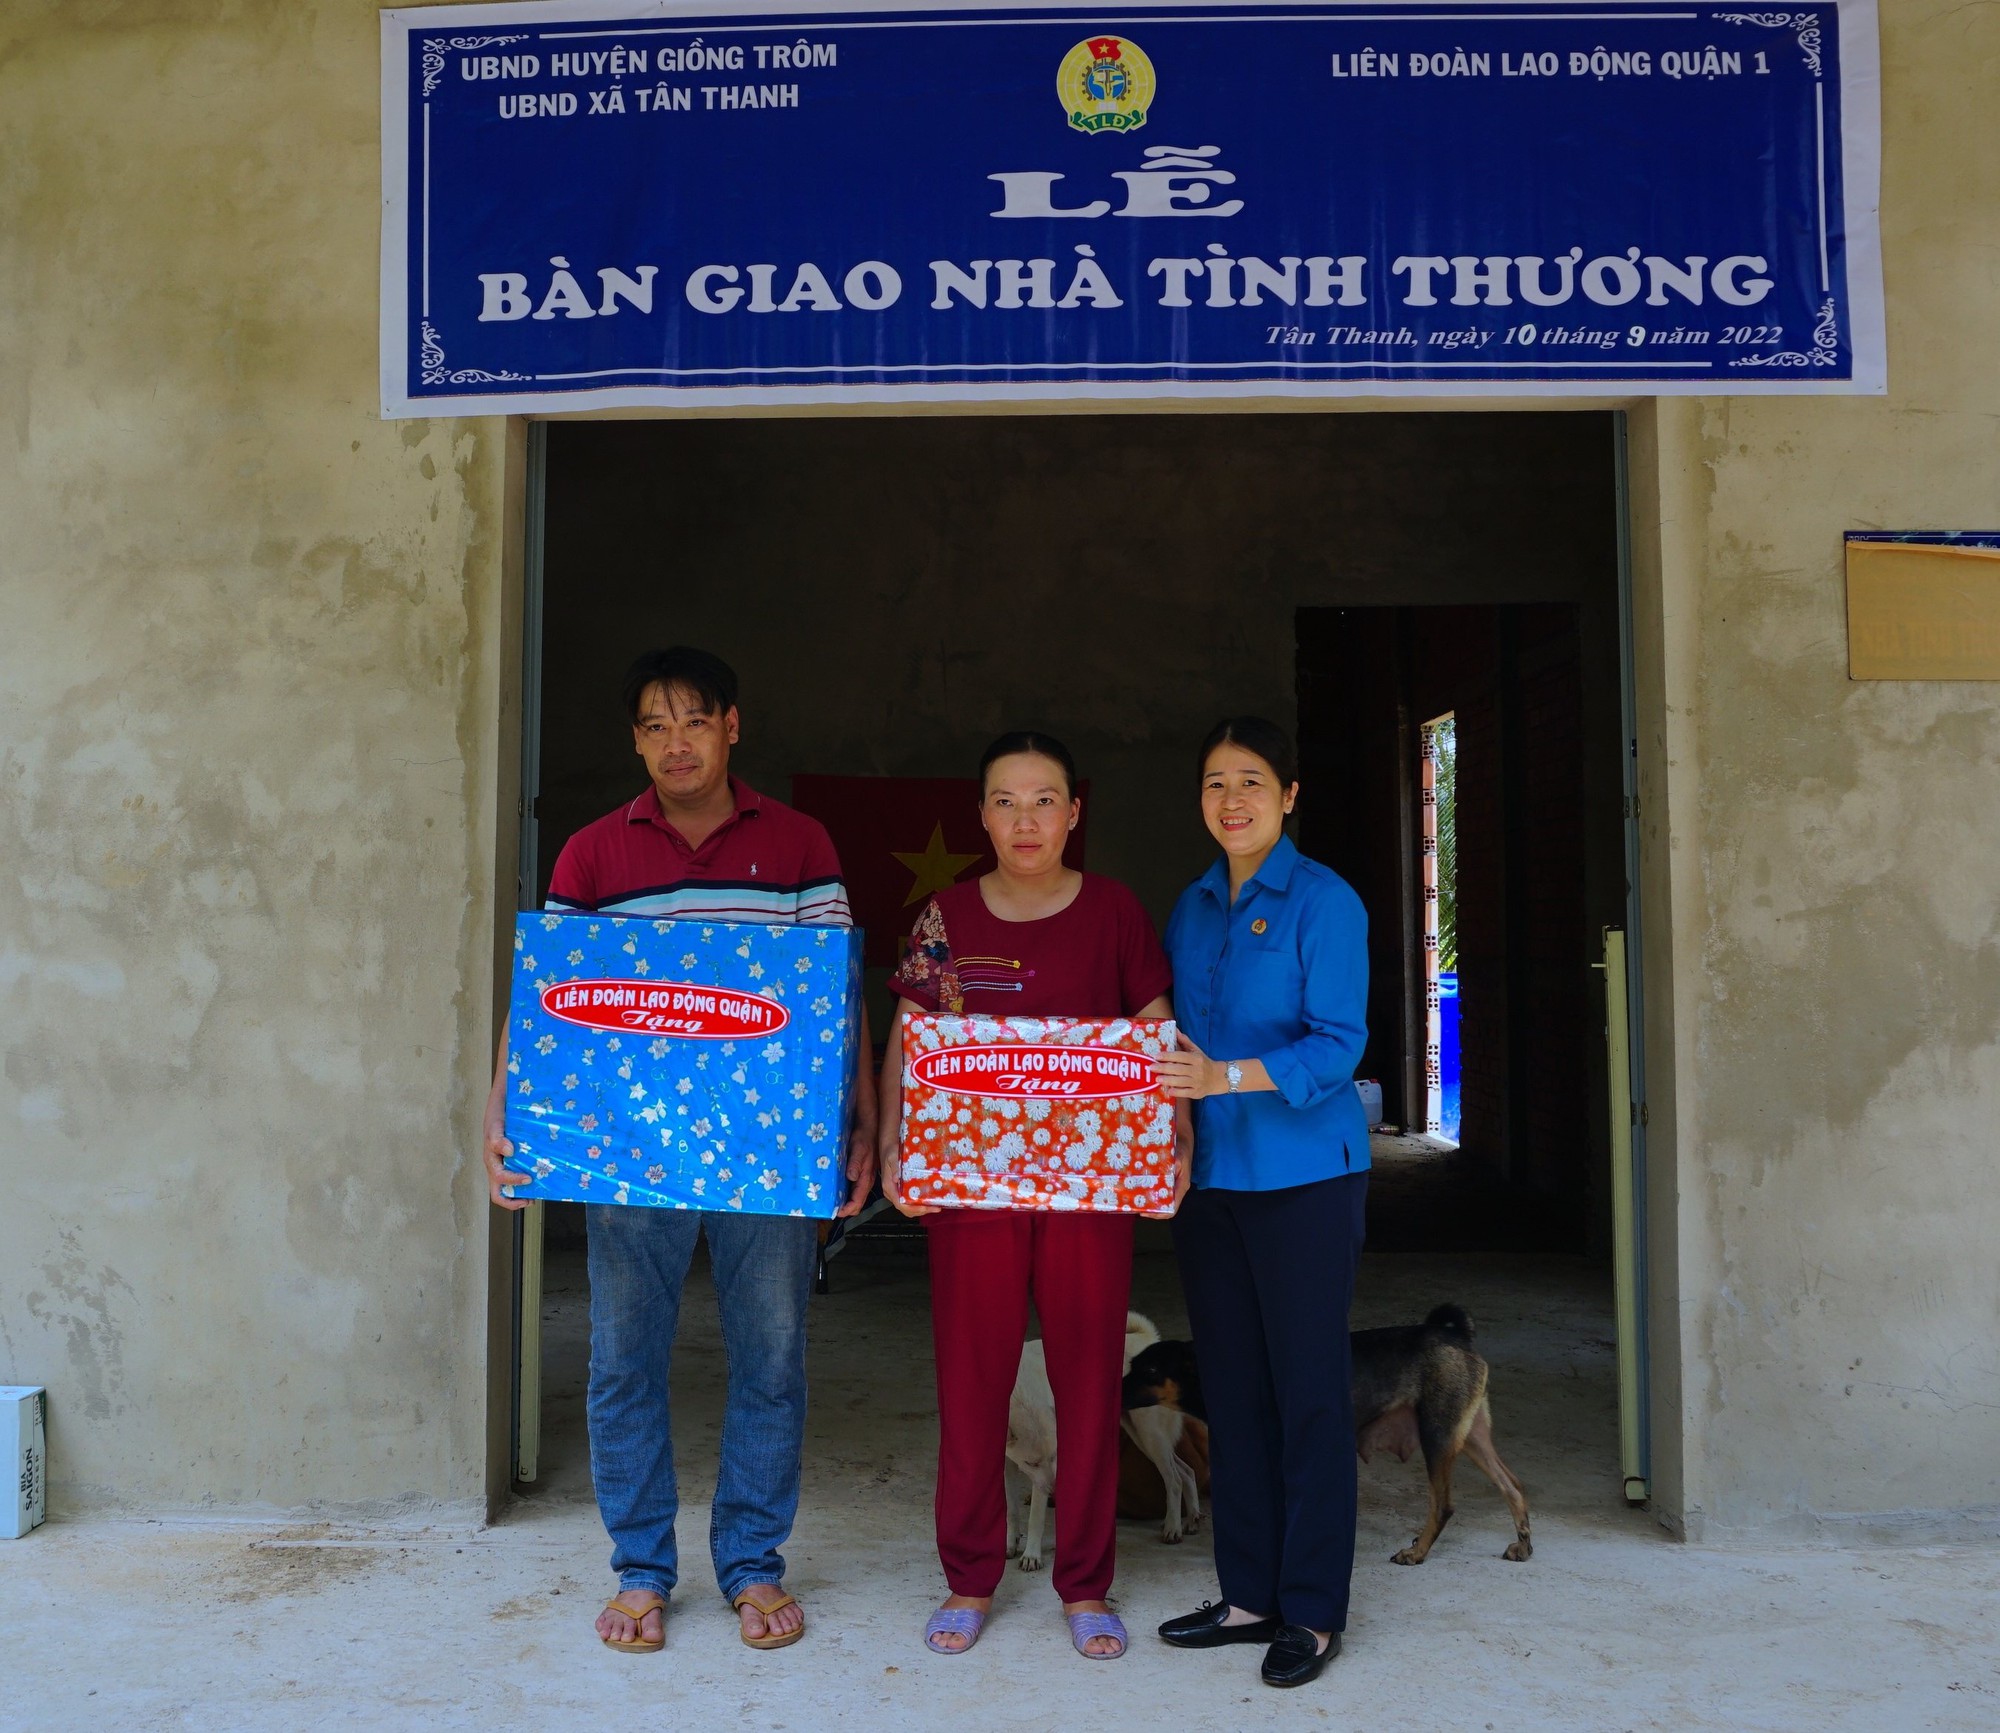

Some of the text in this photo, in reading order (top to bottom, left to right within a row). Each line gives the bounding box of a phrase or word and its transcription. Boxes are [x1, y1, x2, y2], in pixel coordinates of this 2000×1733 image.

[461, 37, 837, 81] UBND HUYỆN GIỒNG TRÔM
[1332, 45, 1771, 82] LIÊN ĐOÀN LAO ĐỘNG QUẬN 1
[499, 81, 799, 119] UBND XÃ TÂN THANH
[1087, 114, 1126, 130] TLĐ
[986, 145, 1245, 219] LỄ
[477, 243, 1775, 322] BÀN GIAO NHÀ TÌNH THƯƠNG
[1265, 323, 1784, 350] Tân Thanh, ngày 10 tháng 9 năm 2022
[555, 985, 772, 1027] LIÊN ĐOÀN LAO ĐỘNG QUẬN 1
[621, 1009, 705, 1033] Tặng
[926, 1050, 1151, 1083] LIÊN ĐOÀN LAO ĐỘNG QUẬN 1
[995, 1073, 1083, 1094] Tặng
[25, 1447, 33, 1511] SAIGON
